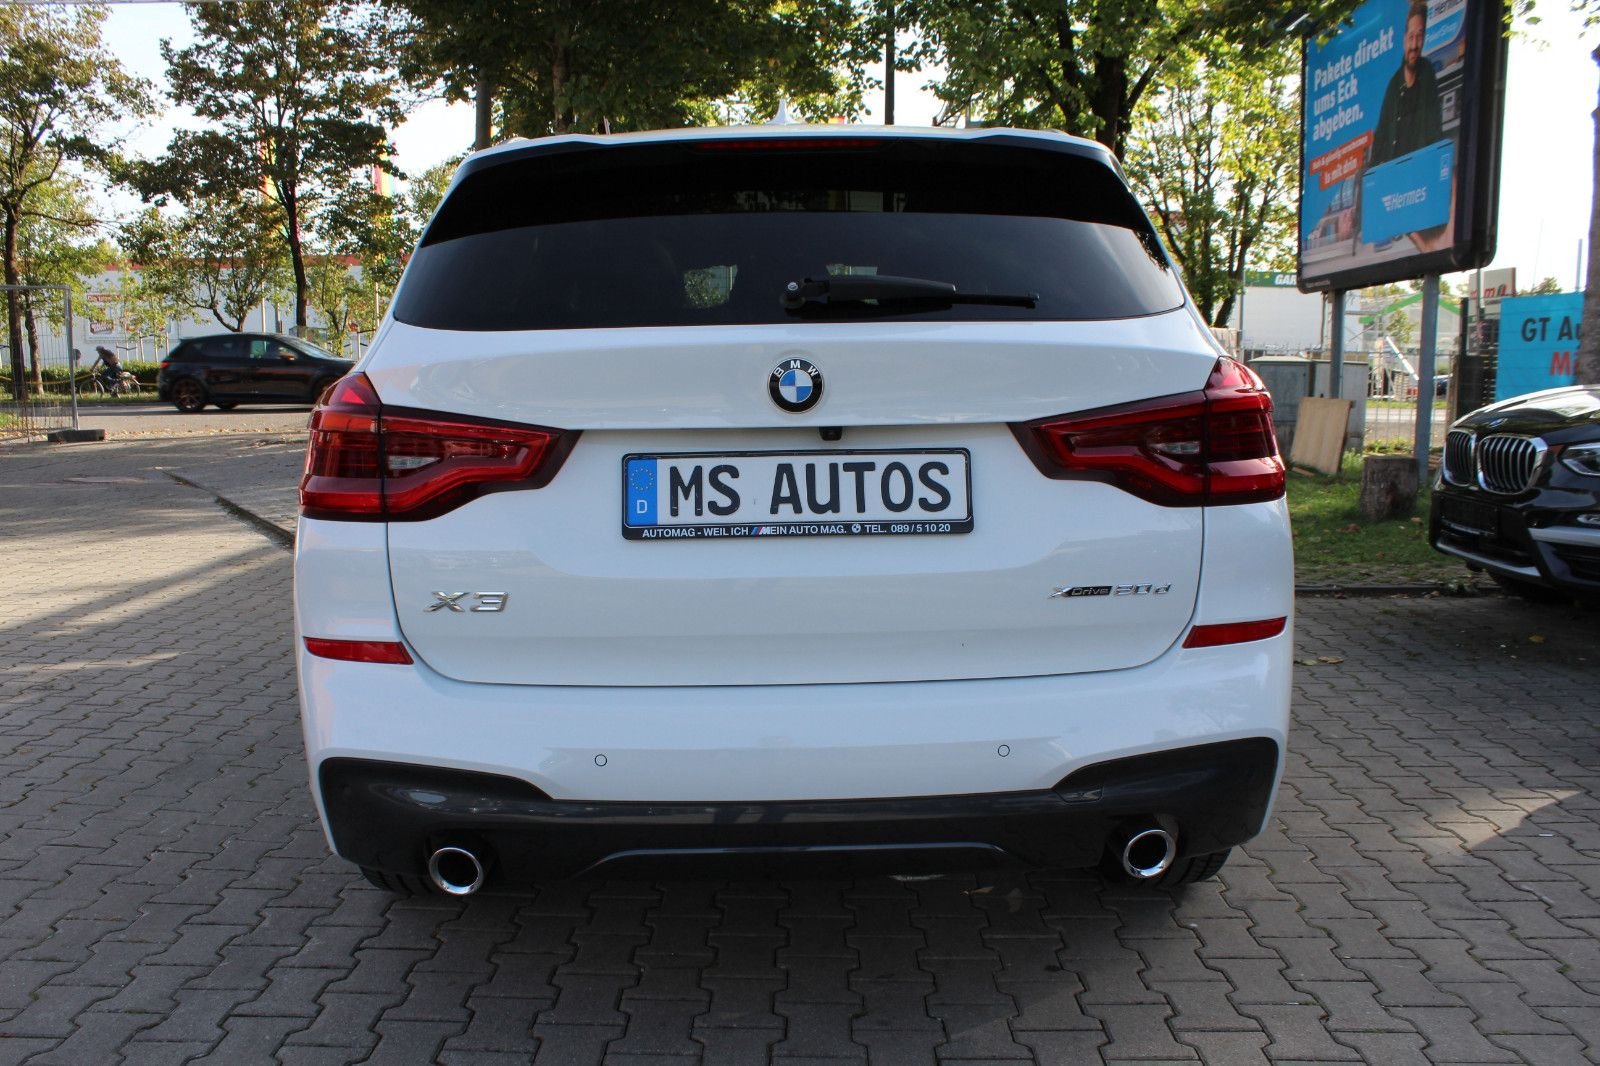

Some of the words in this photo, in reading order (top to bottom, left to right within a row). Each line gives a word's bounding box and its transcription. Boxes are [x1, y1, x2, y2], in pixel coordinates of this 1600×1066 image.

[1314, 55, 1352, 91] Pakete
[1354, 26, 1394, 68] direkt
[1314, 91, 1336, 116] ums
[1337, 73, 1358, 103] Eck
[1313, 104, 1364, 141] abgeben.
[1391, 186, 1428, 210] Hermes
[1521, 317, 1551, 342] GT
[774, 360, 819, 378] BMW
[669, 465, 741, 517] MS
[769, 461, 951, 515] AUTOS
[636, 500, 648, 514] D
[642, 527, 695, 538] AUTOMAG
[703, 527, 729, 537] WEIL
[731, 526, 749, 536] ICH
[789, 525, 819, 535] AUTO
[820, 525, 847, 534] MAG.
[865, 524, 887, 533] TEL.
[423, 591, 508, 613] X3
